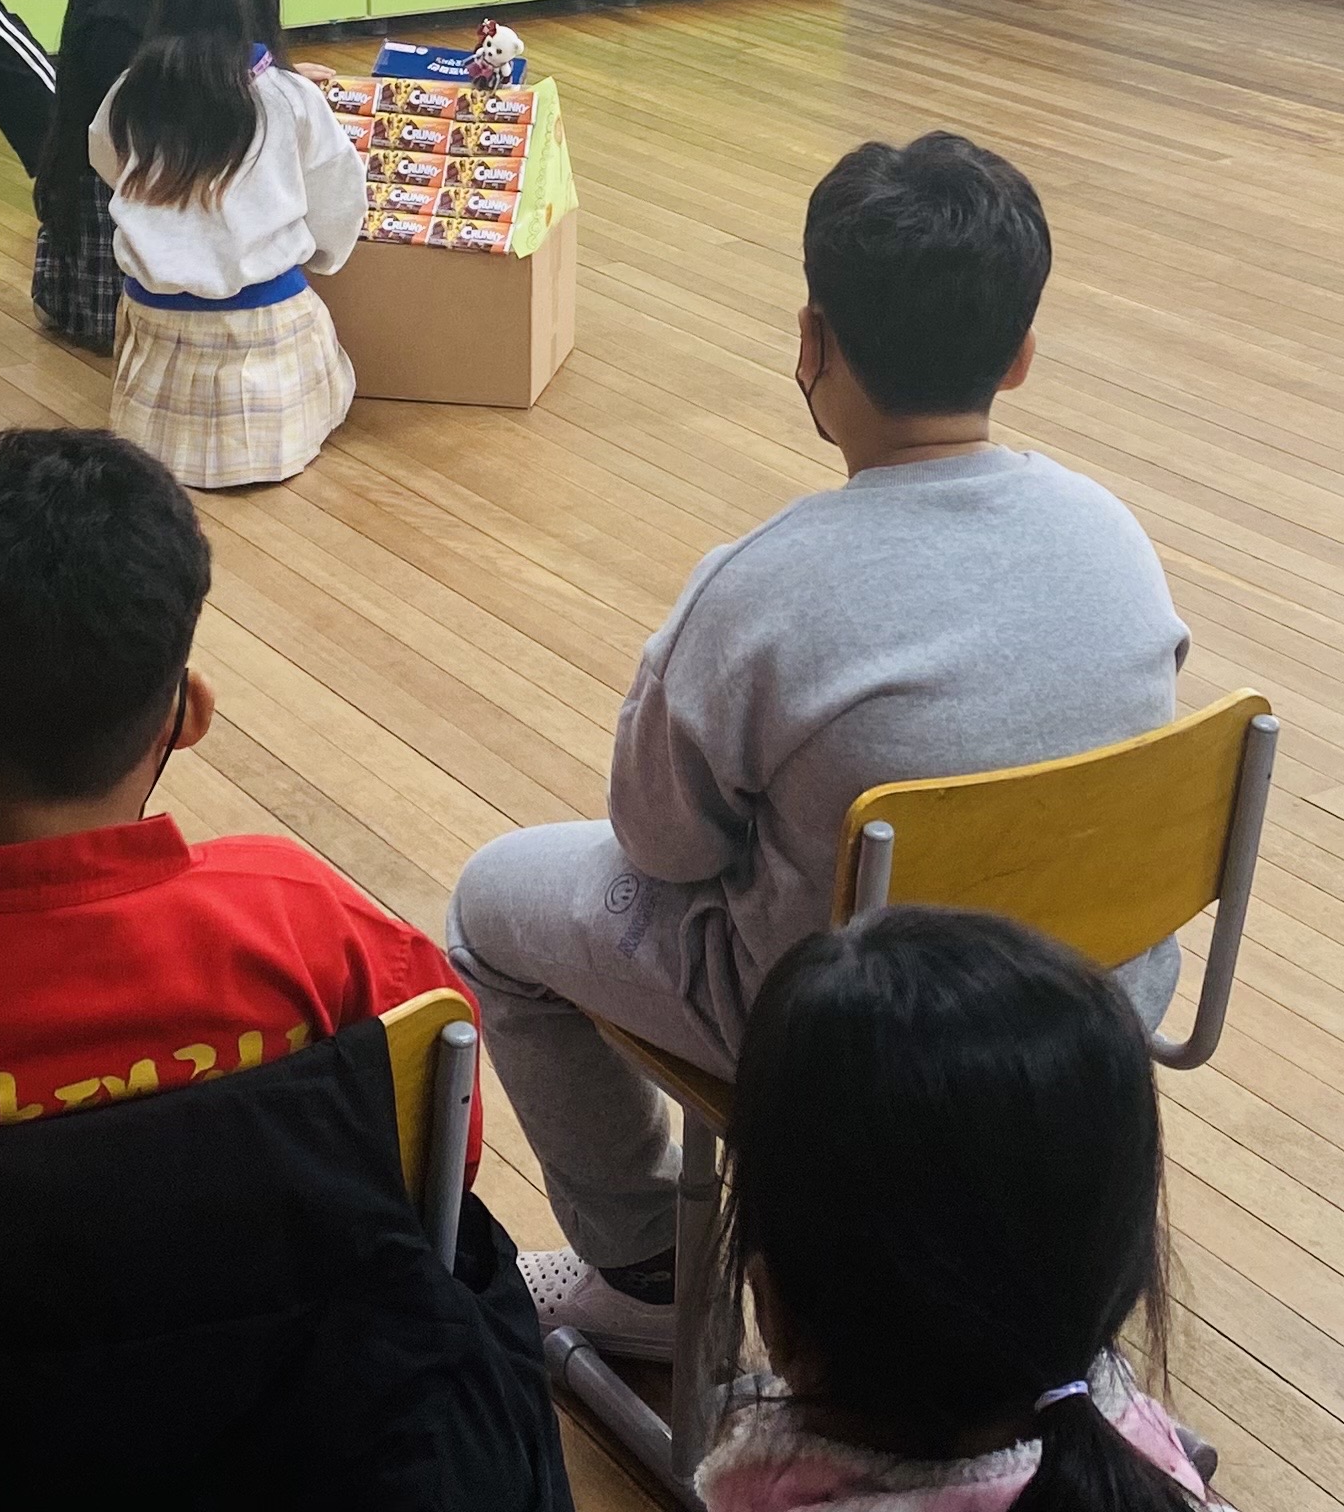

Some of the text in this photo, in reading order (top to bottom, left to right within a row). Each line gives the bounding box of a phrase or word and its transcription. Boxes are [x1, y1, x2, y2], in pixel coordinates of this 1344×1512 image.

[328, 87, 372, 104] CRUNKY
[409, 90, 454, 108] CRUNKY
[486, 98, 530, 115] CRUNKY
[402, 125, 446, 143] CRUNKY
[480, 131, 524, 147] CRUNKY
[398, 160, 441, 177] CRUNKY
[474, 166, 517, 181] CRUNKY
[390, 190, 433, 205] CRUNKY
[468, 196, 512, 211] CRUNKY
[382, 218, 426, 233] CRUNKY
[460, 226, 505, 242] CRUNKY
